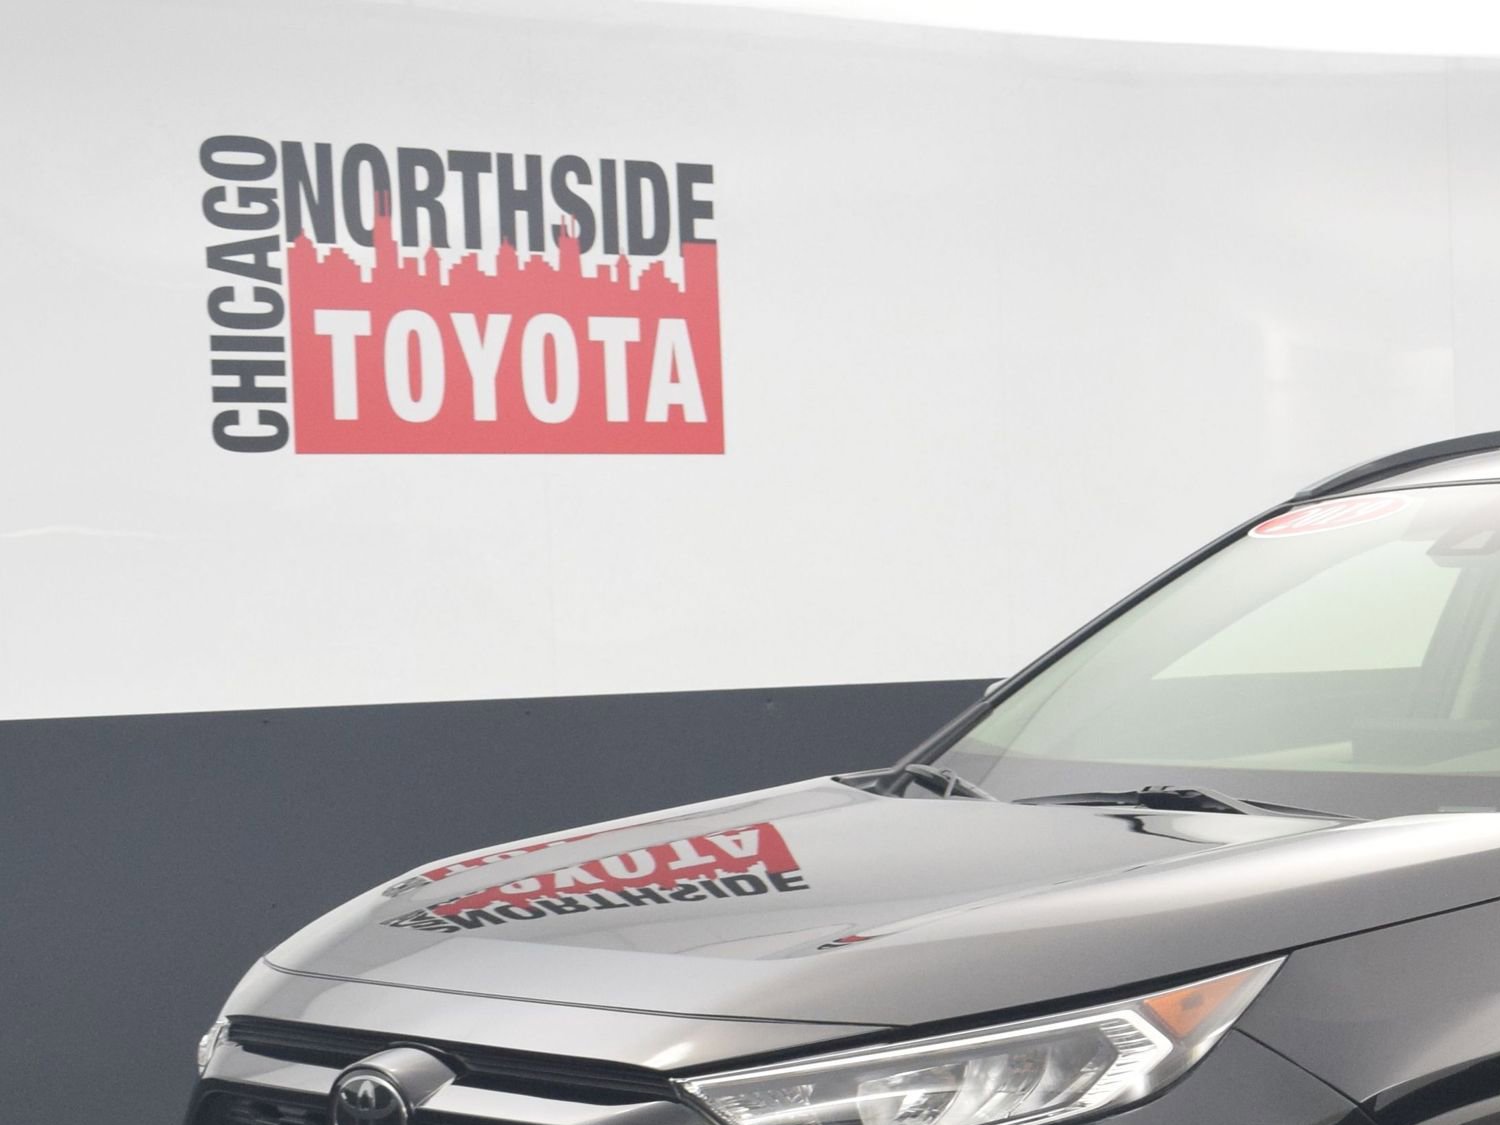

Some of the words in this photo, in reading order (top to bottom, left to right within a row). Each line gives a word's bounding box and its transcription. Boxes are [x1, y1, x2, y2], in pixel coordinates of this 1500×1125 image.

[281, 140, 717, 257] NORTHSIDE
[198, 134, 290, 453] CHICAGO
[313, 308, 708, 424] TOYOTA
